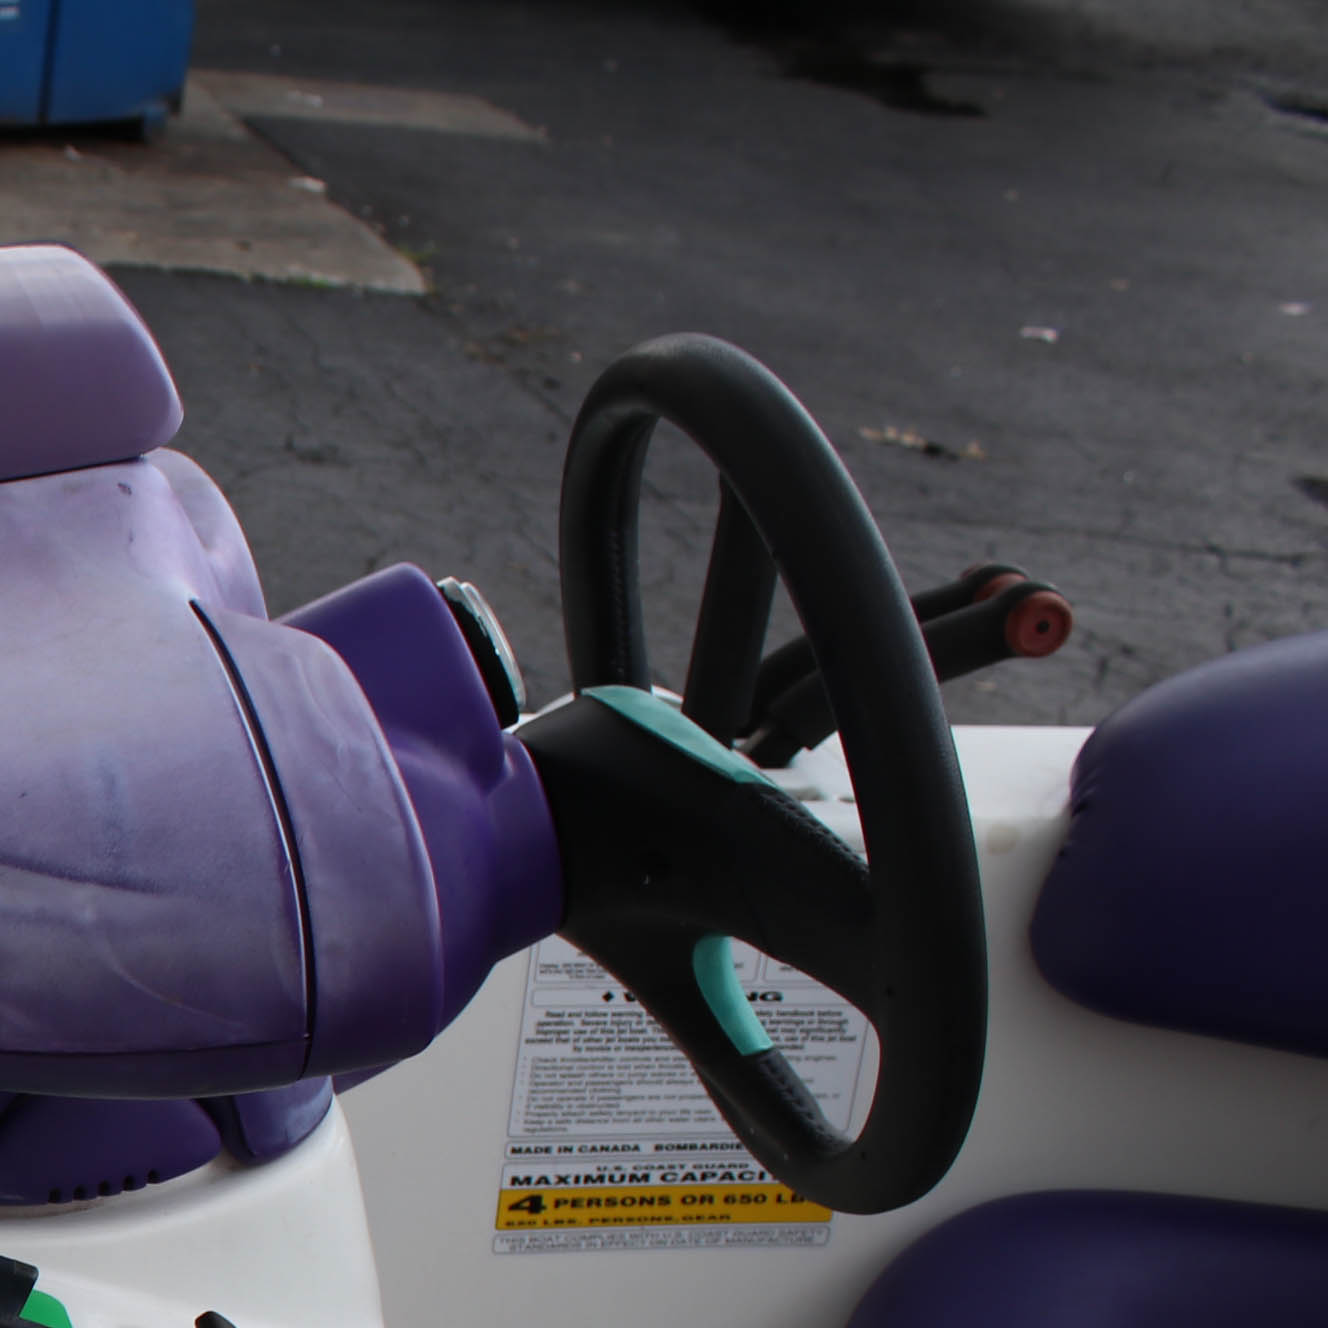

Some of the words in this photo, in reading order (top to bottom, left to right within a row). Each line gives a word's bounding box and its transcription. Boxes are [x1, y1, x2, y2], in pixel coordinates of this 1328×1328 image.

[511, 1145, 553, 1154] MADE
[558, 1144, 574, 1153] IN
[577, 1144, 641, 1153] CANADA
[653, 1143, 743, 1152] BOMBARDIE
[510, 1173, 651, 1186] MAXIMUM
[660, 1171, 767, 1182] CAPACI
[508, 1193, 548, 1215] 4
[554, 1195, 672, 1209] PERSONS
[680, 1194, 715, 1206] OR
[723, 1193, 768, 1205] 650
[776, 1192, 806, 1204] LB
